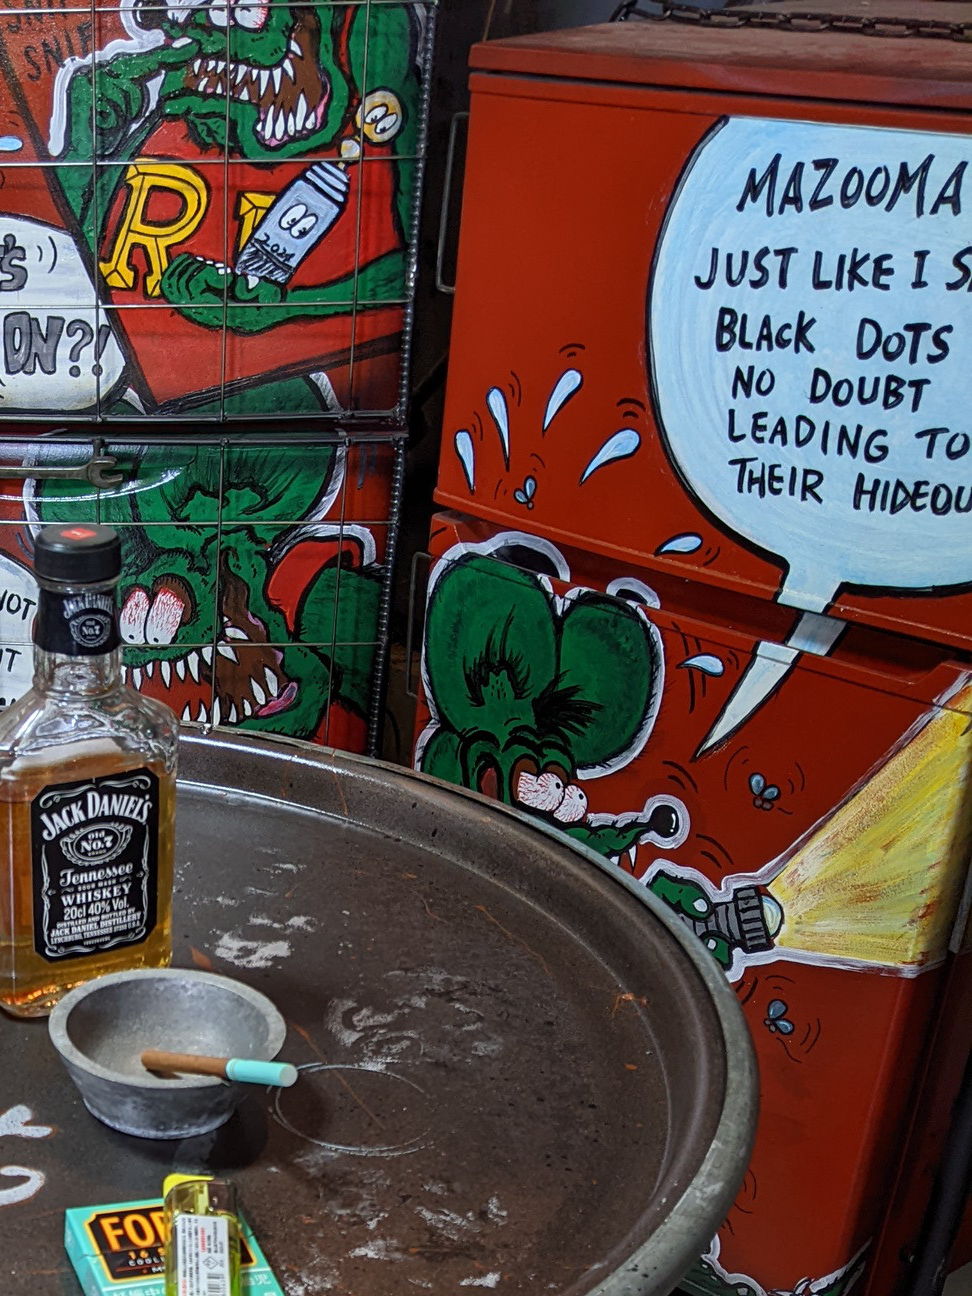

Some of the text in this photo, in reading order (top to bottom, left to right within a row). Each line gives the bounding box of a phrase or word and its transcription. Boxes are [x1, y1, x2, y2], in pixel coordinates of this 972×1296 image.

[735, 152, 970, 218] MAZOOMA
[694, 246, 799, 290] JUST
[812, 247, 895, 292] LIKE
[910, 249, 931, 290] I
[715, 306, 954, 365] BLACK DOTS
[731, 365, 932, 413] NO DOUBT
[728, 408, 971, 464] LEADING TO
[728, 457, 825, 505] THEIR
[40, 791, 153, 841] JACK DANIEL'S
[88, 830, 105, 840] Old
[80, 835, 113, 853] No.7
[59, 862, 133, 887] Tennessee
[61, 882, 132, 907] WHISKEY
[64, 904, 86, 921] 20cl
[88, 899, 111, 916] 40%
[100, 1210, 172, 1252] FOR
